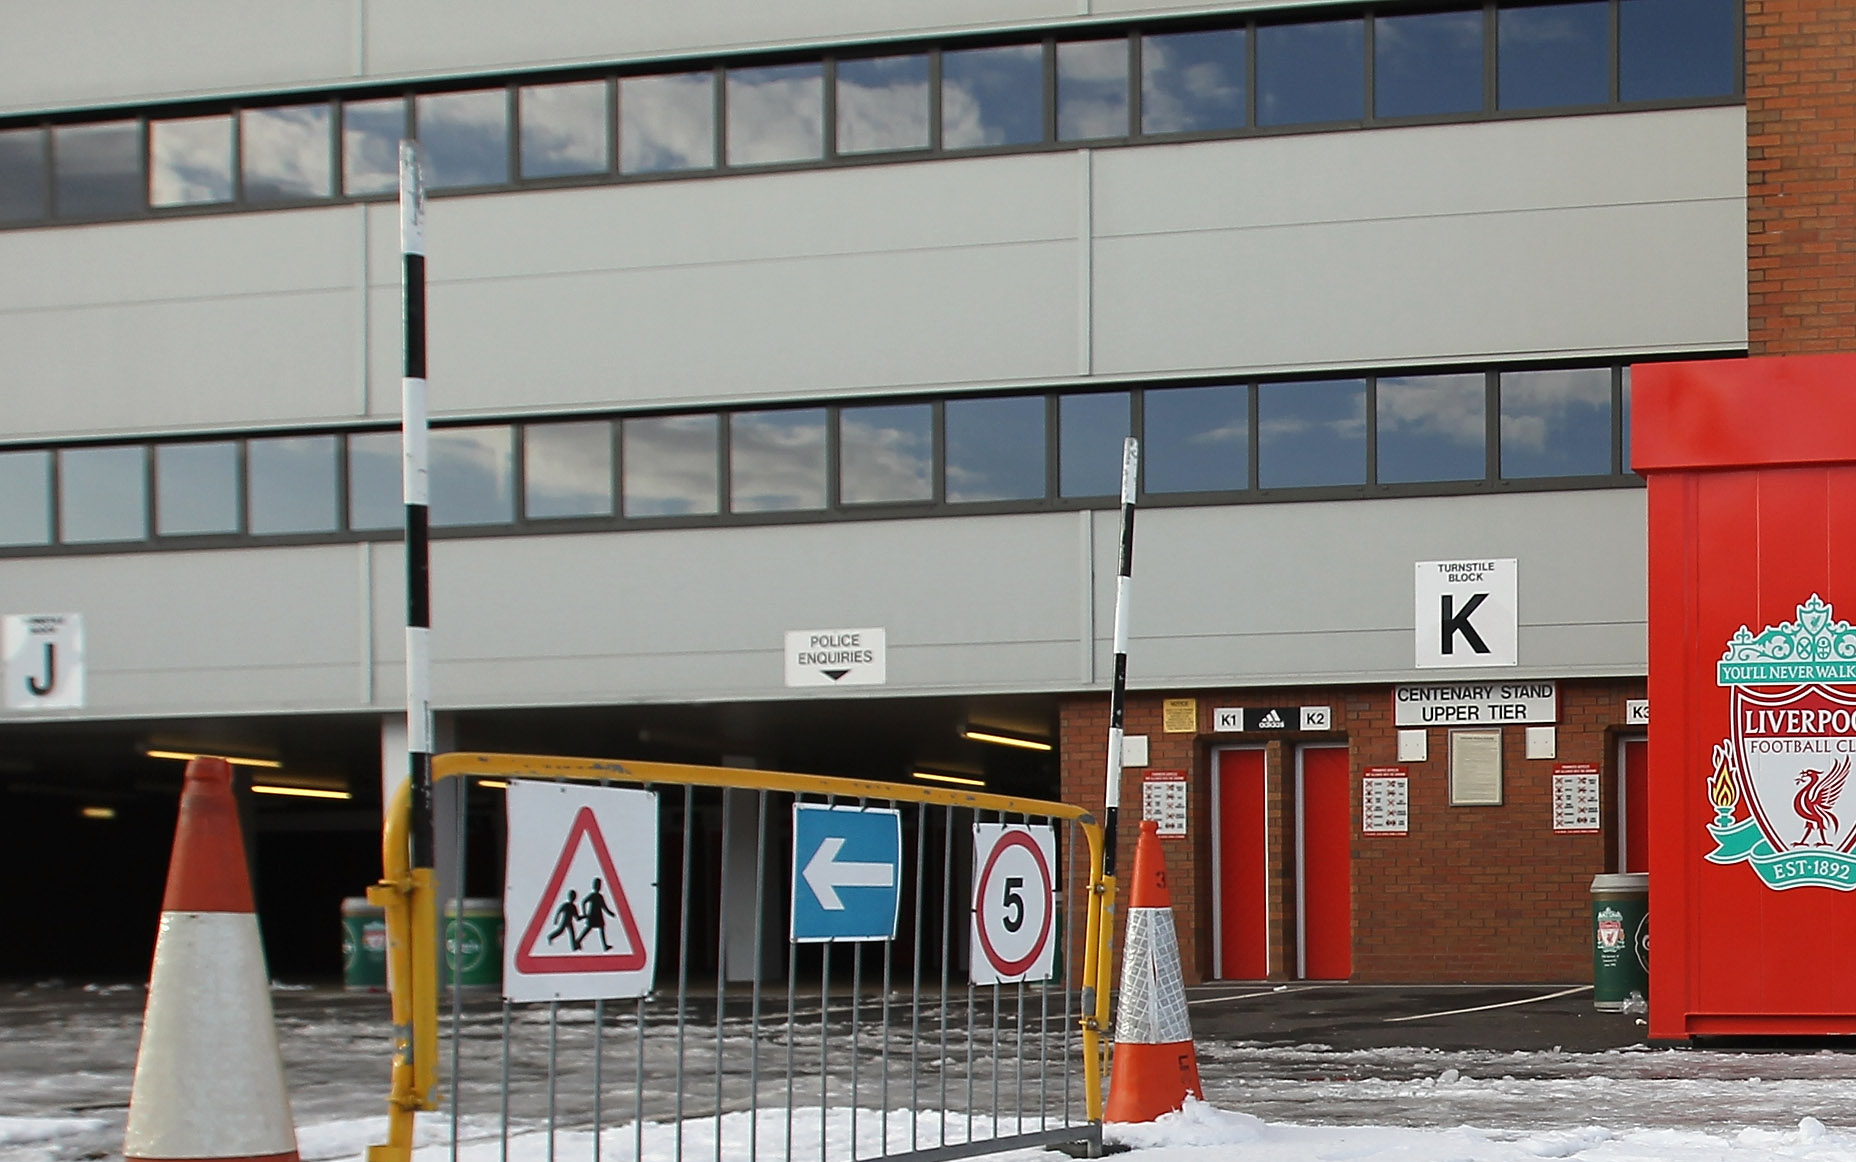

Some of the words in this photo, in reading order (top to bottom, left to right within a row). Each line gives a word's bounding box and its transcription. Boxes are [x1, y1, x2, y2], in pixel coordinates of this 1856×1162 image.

[1438, 562, 1495, 572] TURNSTILE
[1448, 573, 1484, 582] BLOCK
[1441, 593, 1491, 655] K
[810, 634, 860, 648] POLICE
[798, 650, 873, 665] ENQUIRIES
[25, 642, 55, 696] J
[1722, 666, 1768, 680] YOU'LL
[1769, 665, 1814, 679] NEVER
[1815, 665, 1856, 678] WALK
[1398, 685, 1493, 701] CENTENARY
[1501, 684, 1553, 699] STAND
[1221, 714, 1237, 726] K1
[1306, 713, 1325, 725] K2
[1422, 705, 1480, 721] UPPER
[1488, 704, 1527, 719] TIER
[1750, 740, 1832, 753] FOOTBALL
[1002, 877, 1024, 933] 5
